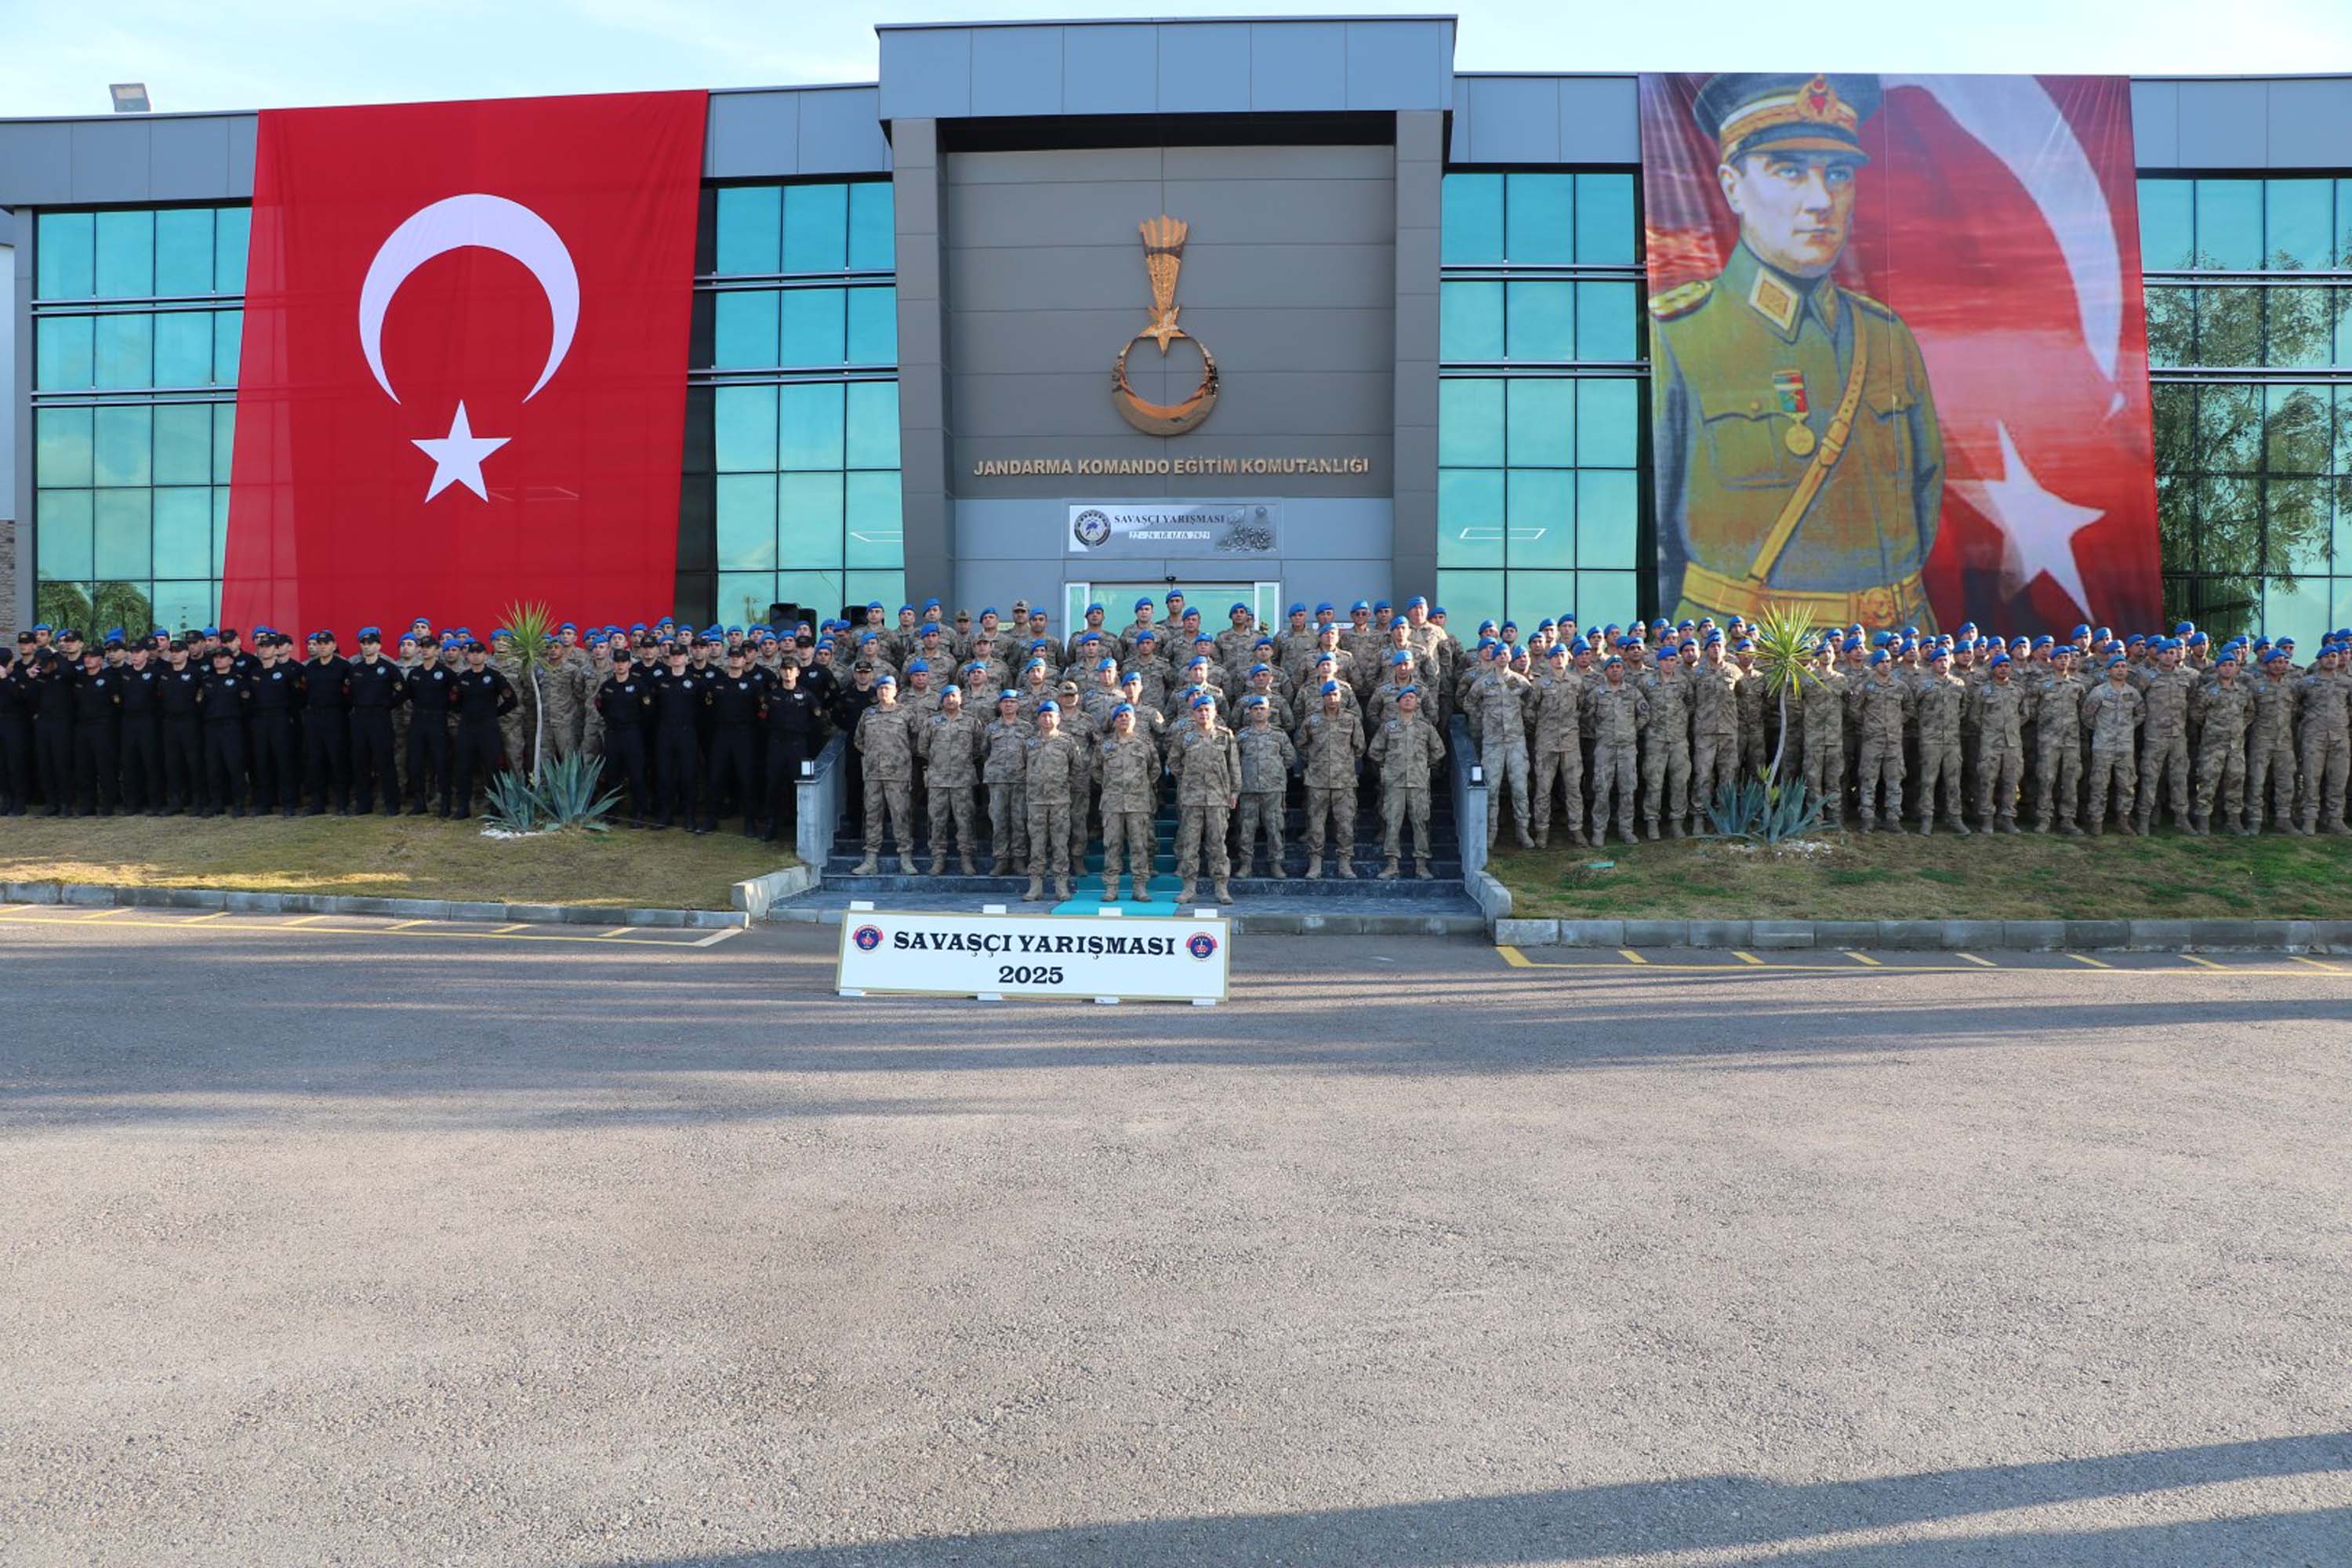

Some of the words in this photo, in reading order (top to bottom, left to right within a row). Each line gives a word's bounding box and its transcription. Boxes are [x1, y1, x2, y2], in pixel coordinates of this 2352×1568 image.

[974, 460, 1073, 475] JANDARMA
[1078, 459, 1169, 474] KOMANDO
[1174, 456, 1236, 474] EĞİTİM
[1241, 457, 1369, 474] KOMUTANLIĞI
[1114, 514, 1159, 524] SAVAŞÇI
[1163, 514, 1225, 524] YARIŞMASI
[894, 931, 1012, 957] SAVAŞÇI
[1018, 935, 1175, 960] YARIŞMASI
[998, 965, 1064, 984] 2025
